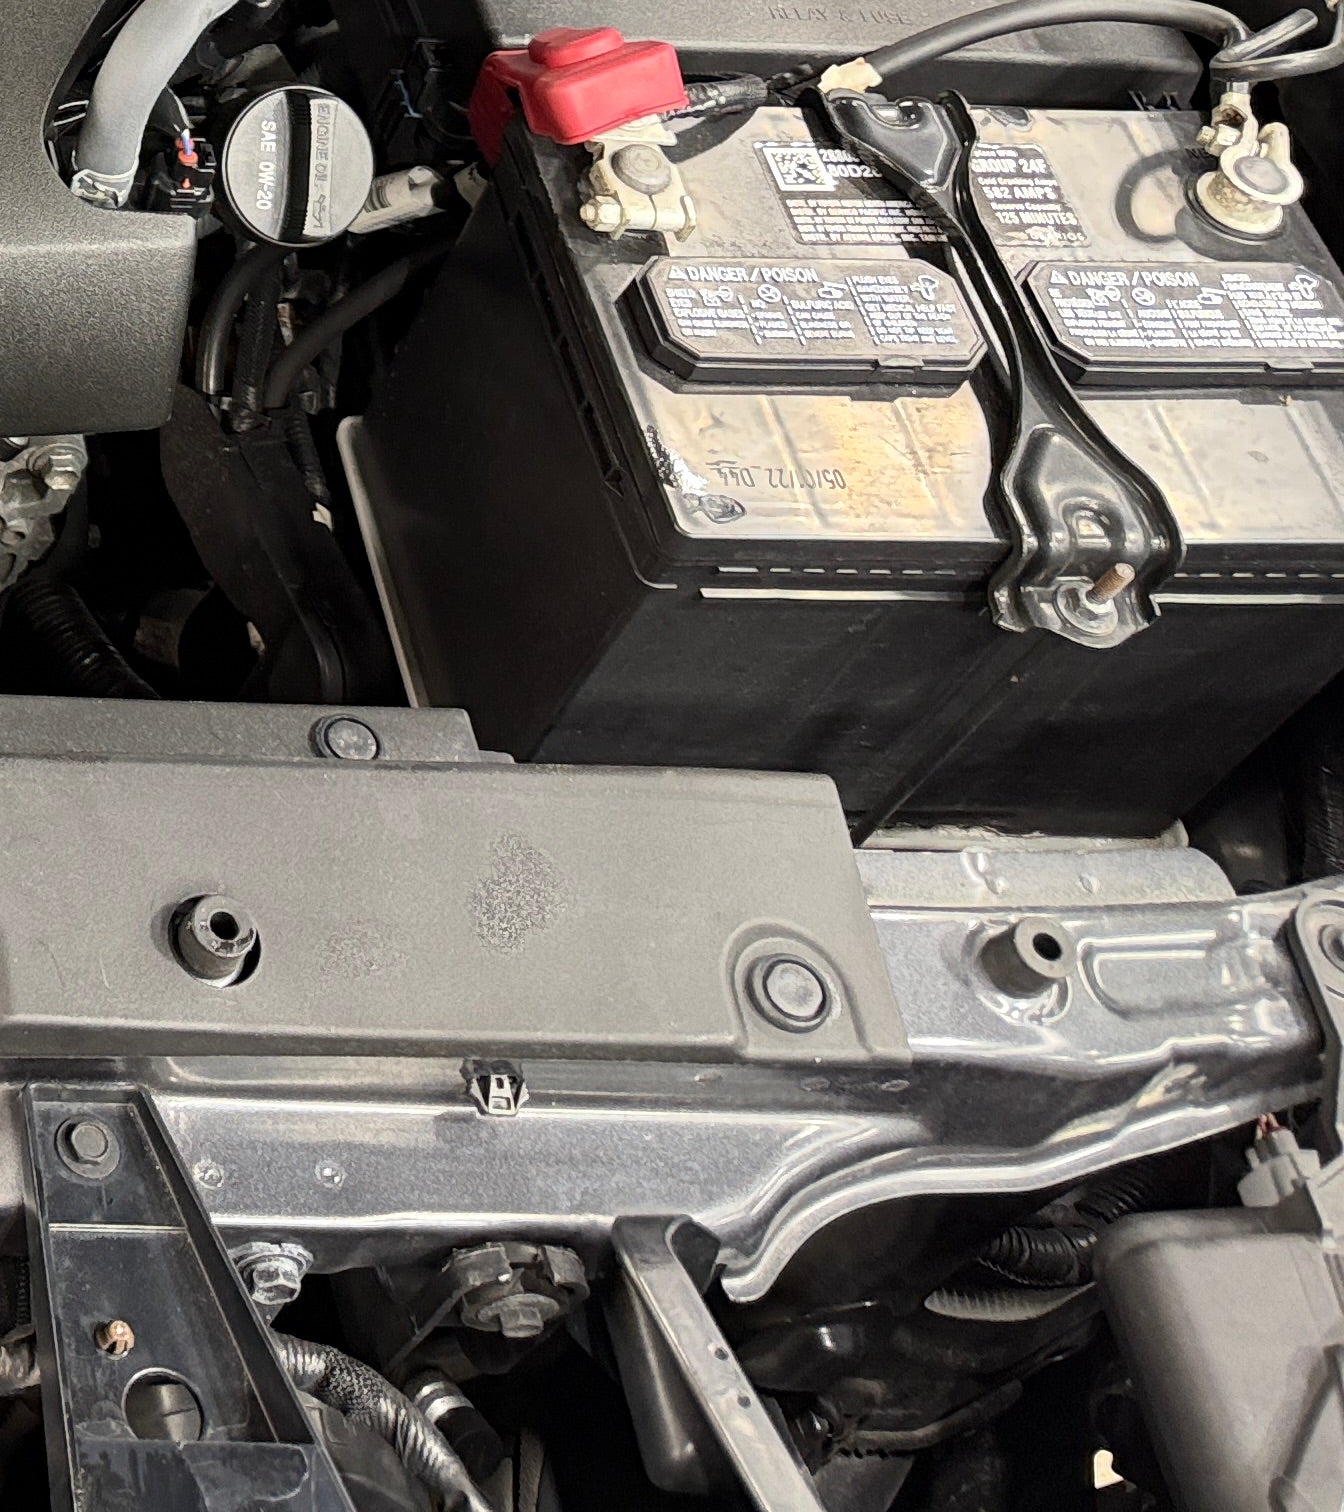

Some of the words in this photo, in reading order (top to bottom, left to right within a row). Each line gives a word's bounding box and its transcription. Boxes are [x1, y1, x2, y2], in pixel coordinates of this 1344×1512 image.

[260, 120, 277, 153] SAE
[315, 102, 331, 161] ENGINE
[314, 163, 328, 182] OIL
[971, 158, 1017, 173] GROUP
[1018, 158, 1047, 174] 24F
[255, 161, 277, 210] 0W-20
[1013, 187, 1058, 200] AMPS
[994, 212, 1020, 224] 125
[1020, 212, 1078, 226] MINUTES
[686, 267, 749, 282] DANGER
[760, 267, 819, 283] POISON
[1067, 271, 1130, 286] DANGER
[1141, 271, 1200, 287] POISON
